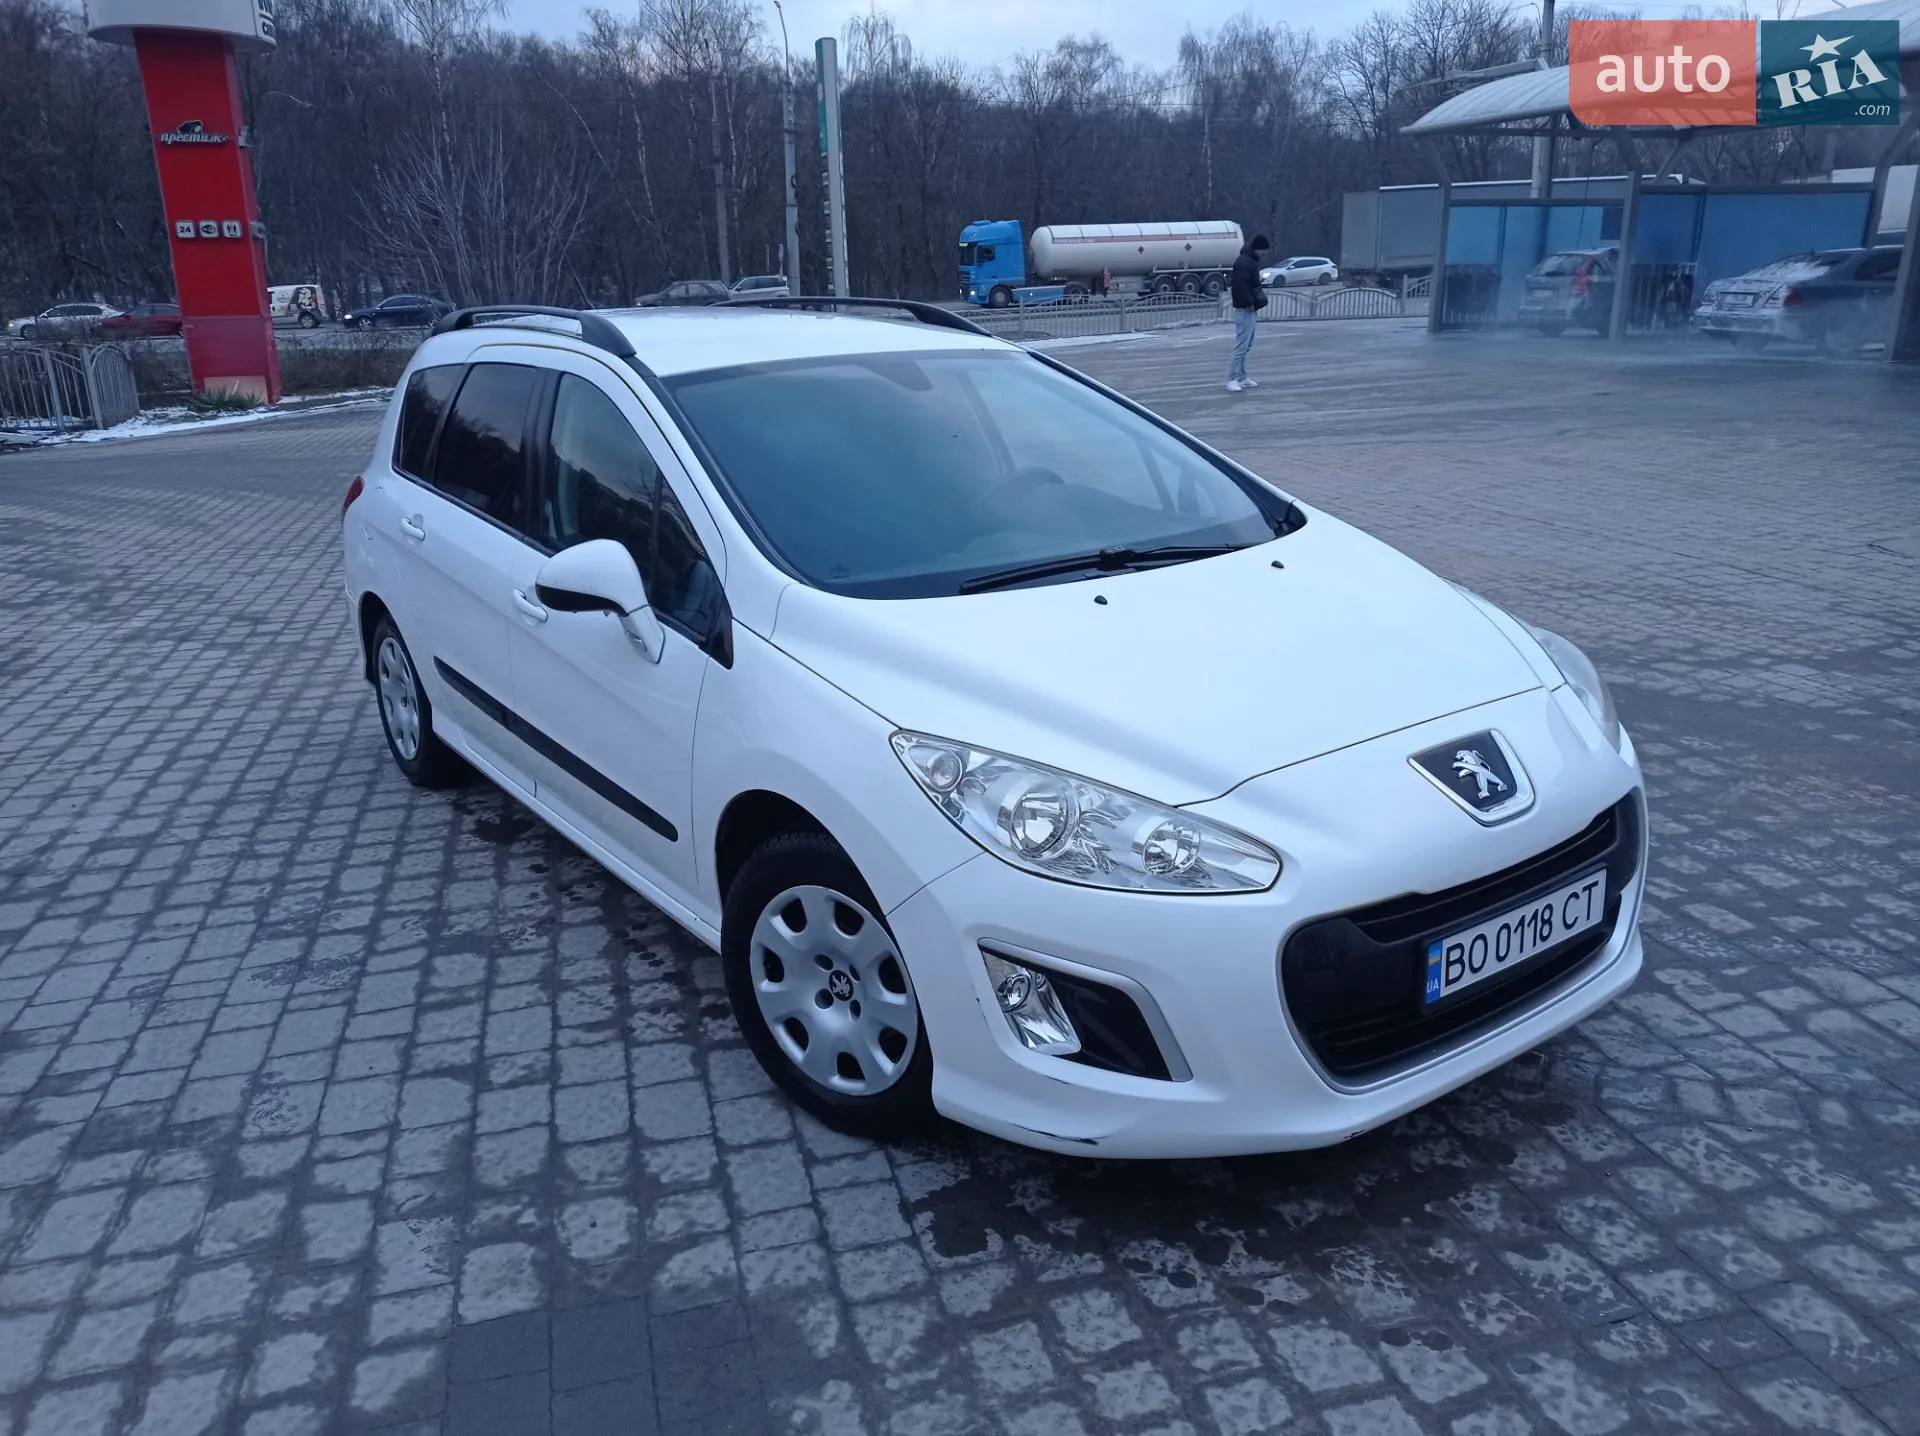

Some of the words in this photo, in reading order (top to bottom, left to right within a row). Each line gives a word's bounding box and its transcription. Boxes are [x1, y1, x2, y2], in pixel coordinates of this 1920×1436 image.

[1445, 933, 1488, 987] BO
[1495, 903, 1553, 962] 0118
[1562, 880, 1599, 930] CT
[1426, 978, 1440, 993] UA
